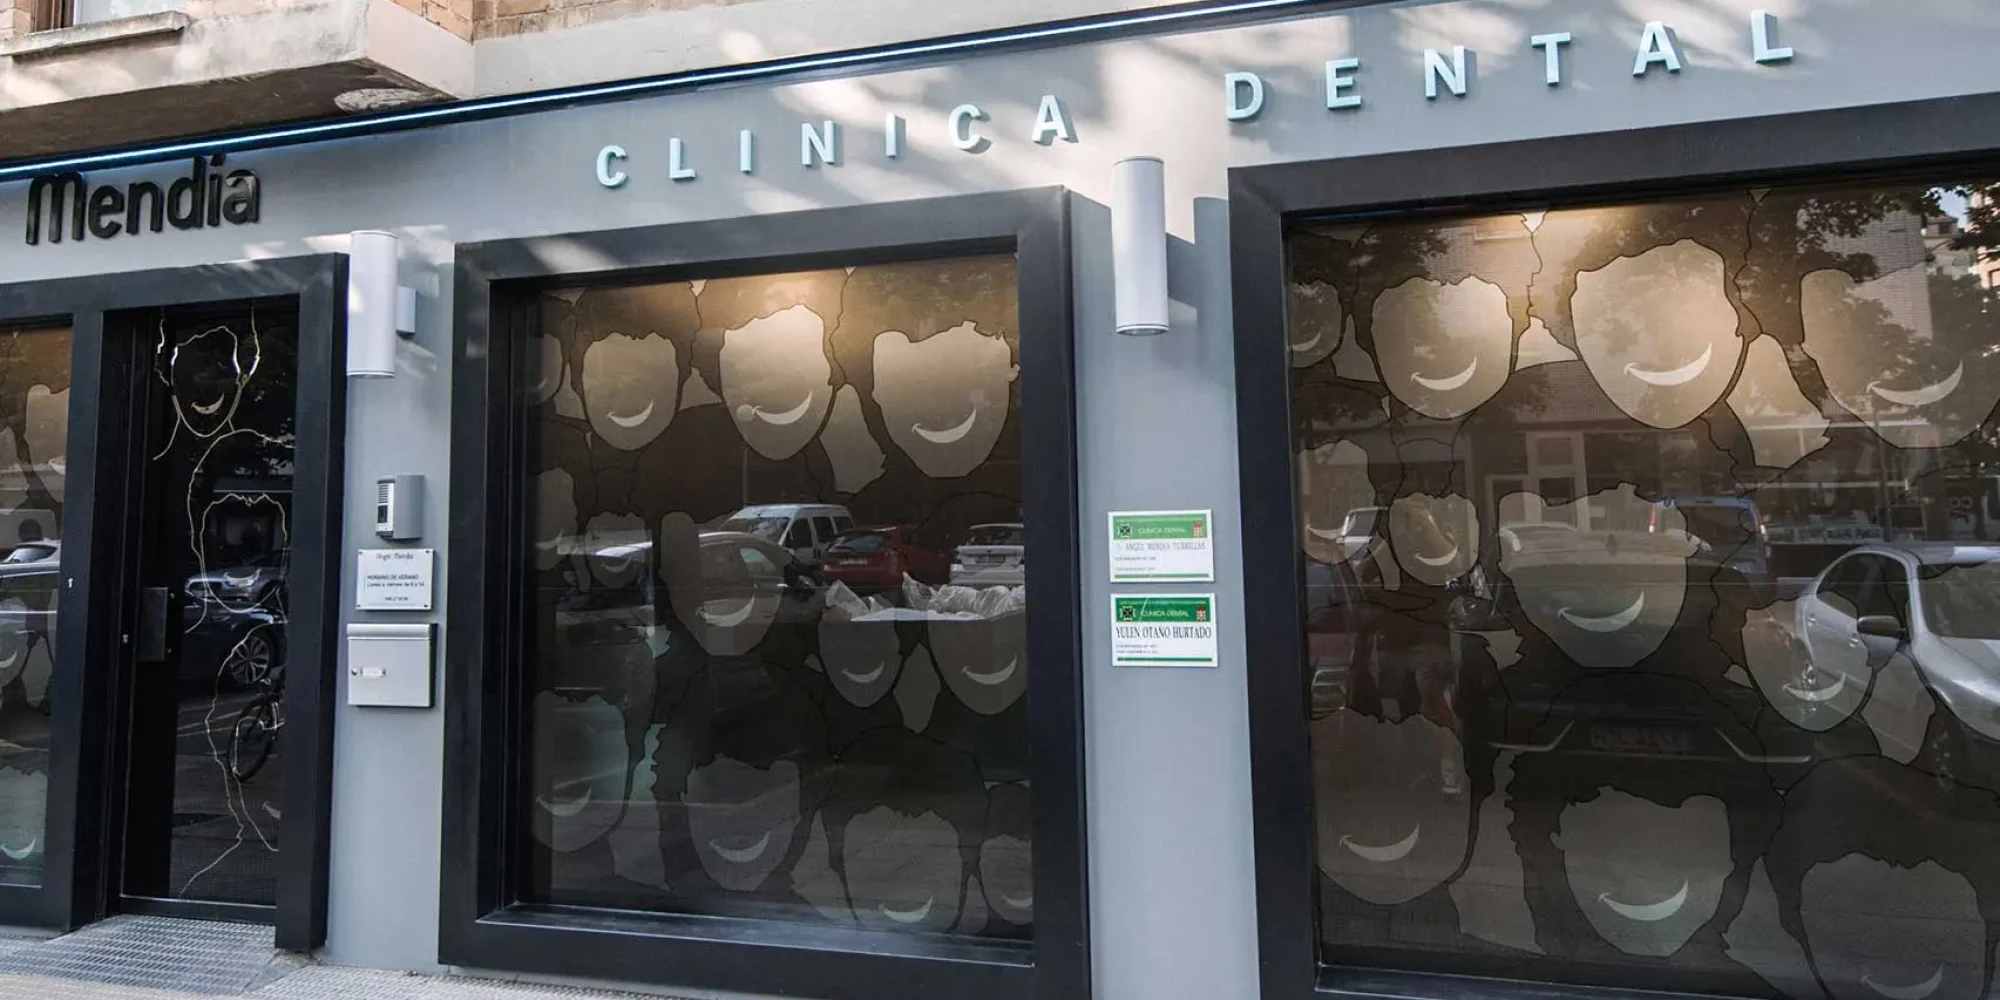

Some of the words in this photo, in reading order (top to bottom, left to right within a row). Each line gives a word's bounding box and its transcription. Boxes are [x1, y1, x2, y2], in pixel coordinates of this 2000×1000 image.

[596, 94, 1074, 188] CLINICA
[1225, 10, 1794, 121] DENTAL
[1172, 626, 1212, 639] HURTADO
